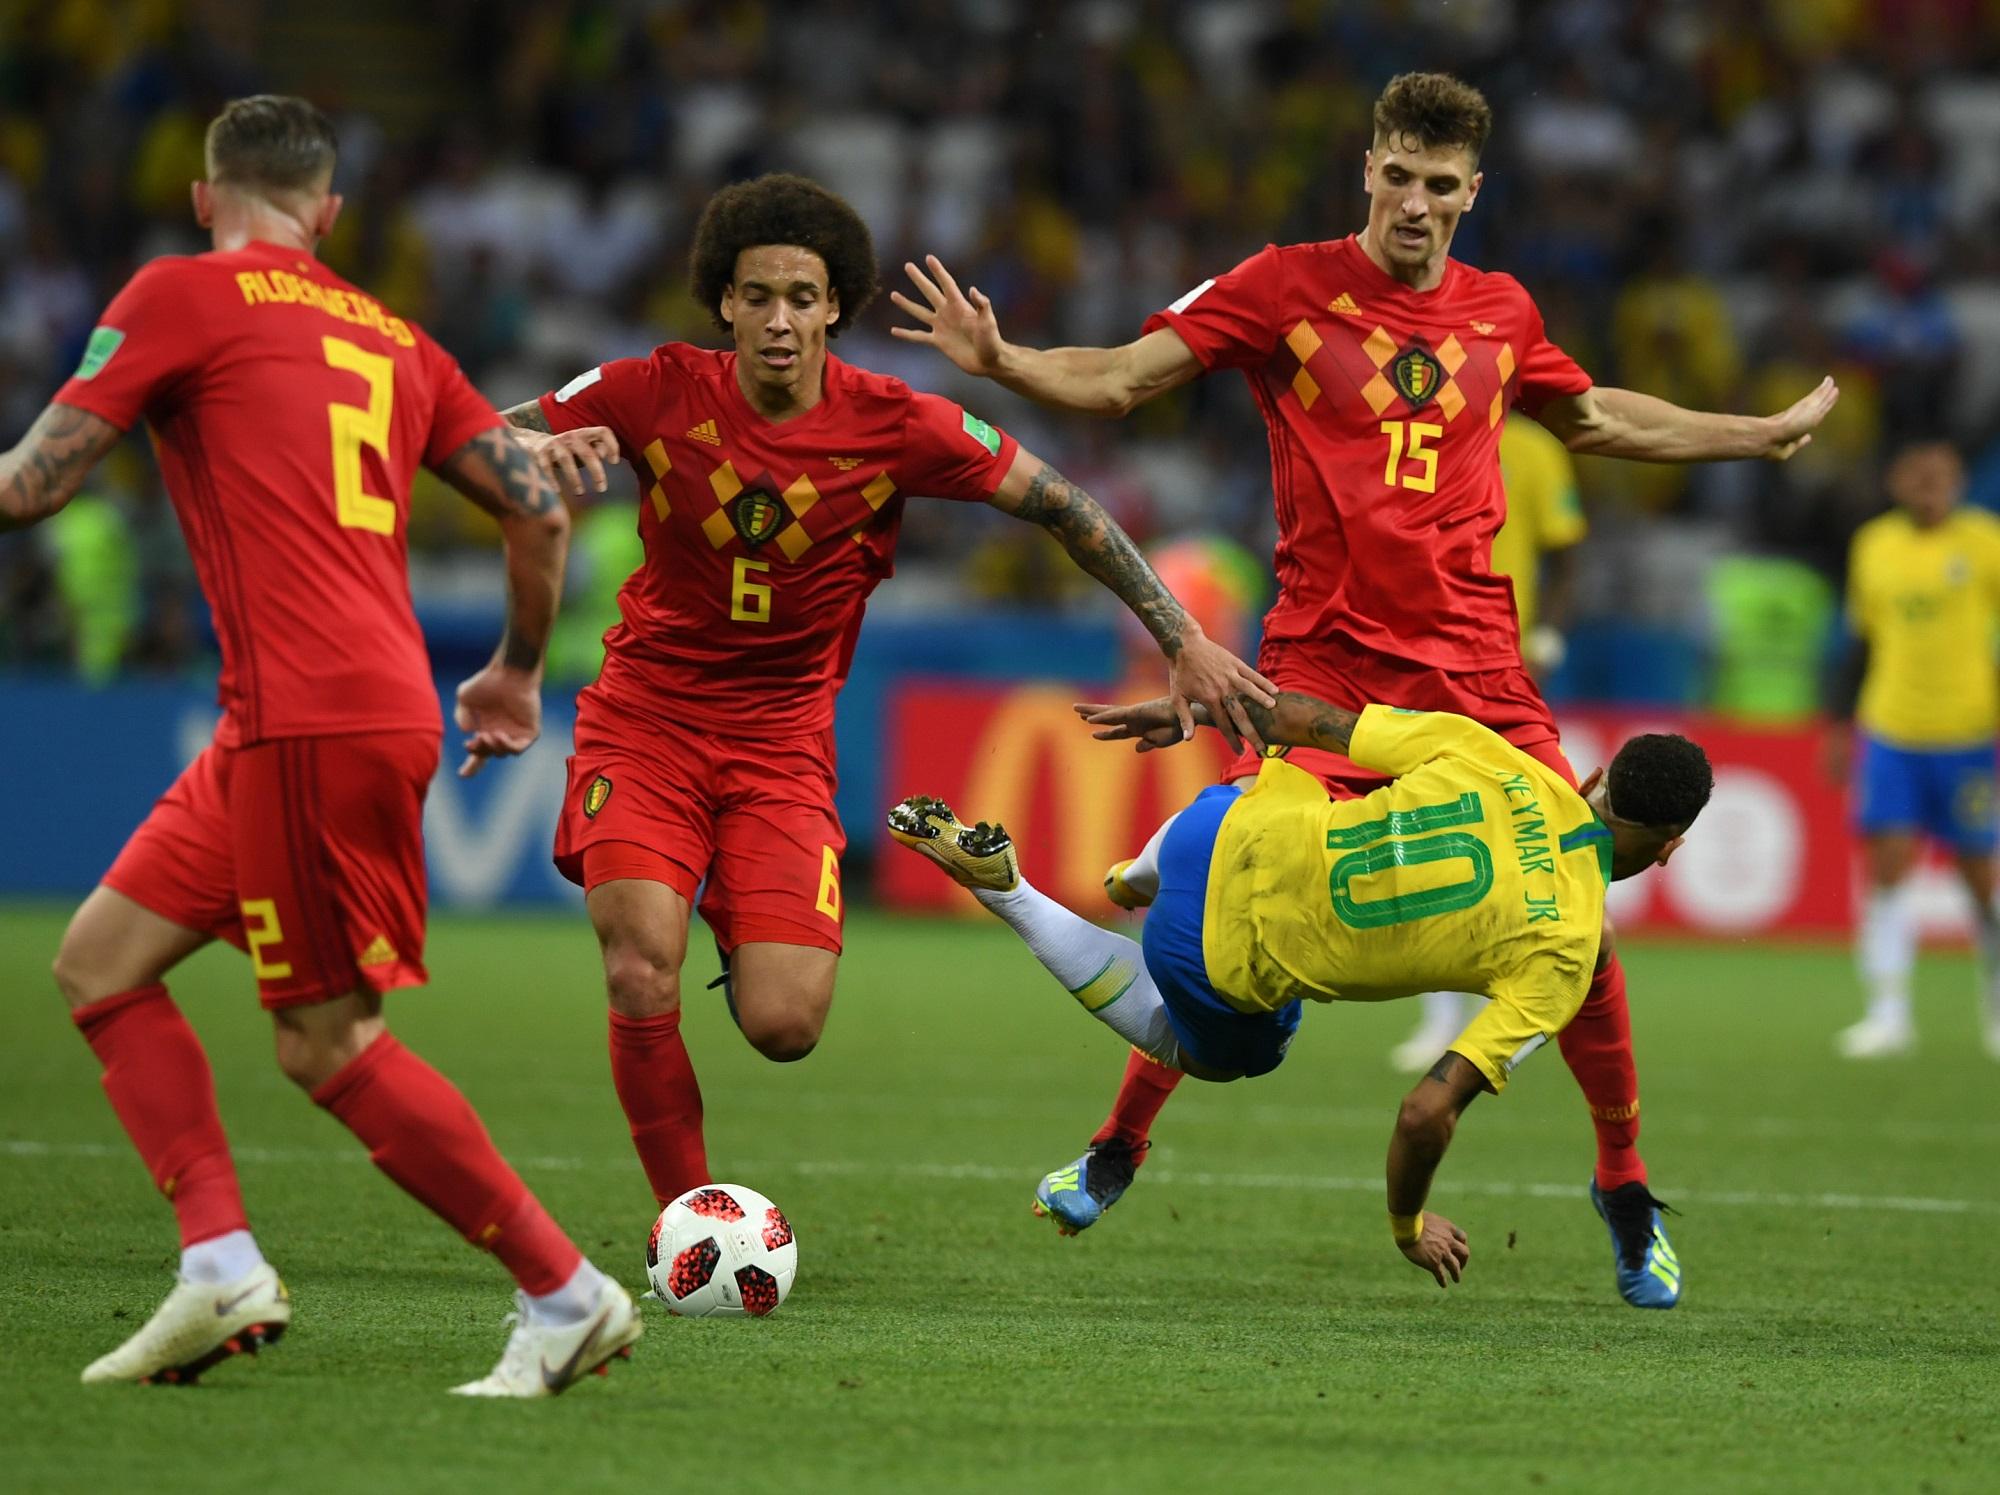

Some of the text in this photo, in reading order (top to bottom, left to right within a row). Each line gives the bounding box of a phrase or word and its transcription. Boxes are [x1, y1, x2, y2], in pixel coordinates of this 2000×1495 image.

[321, 335, 396, 536] 2
[1381, 421, 1443, 493] 15
[731, 556, 772, 623] 6
[816, 844, 840, 923] 6
[1327, 791, 1494, 930] 10
[1496, 772, 1561, 924] NEYMAR JR
[242, 898, 292, 979] 2
